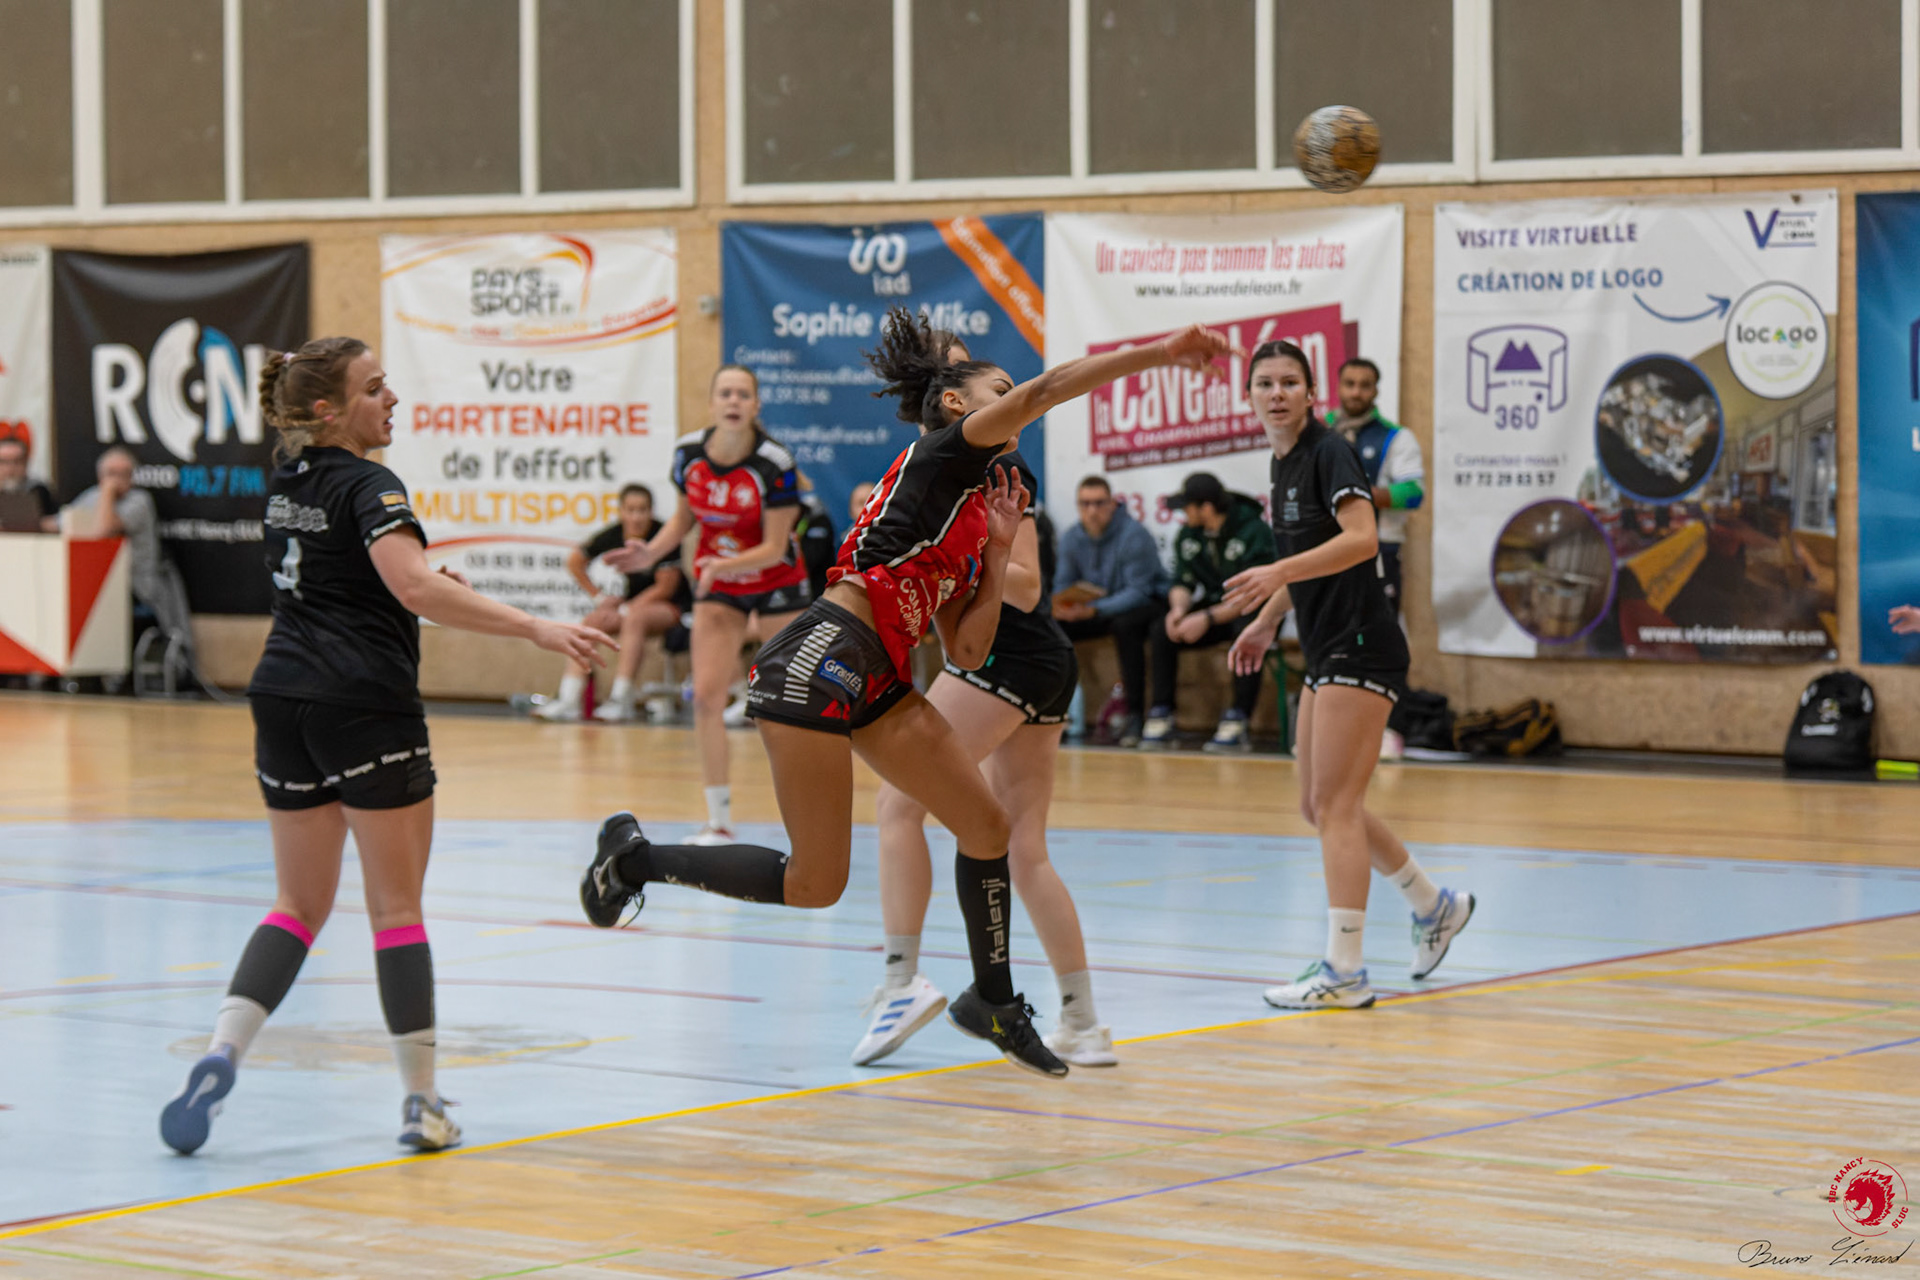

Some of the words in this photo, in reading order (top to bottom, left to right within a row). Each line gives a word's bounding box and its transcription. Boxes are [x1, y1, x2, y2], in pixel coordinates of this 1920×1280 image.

[1456, 228, 1519, 249] VISITE
[1526, 223, 1638, 246] VIRTUELLE
[1457, 267, 1564, 293] CRÉATION
[1572, 269, 1595, 289] DE
[1602, 267, 1663, 289] LOGO
[772, 302, 873, 344] Sophie
[482, 360, 574, 393] Votre
[412, 404, 650, 436] PARTENAIRE
[443, 450, 480, 479] de
[496, 449, 613, 480] l'effort
[981, 878, 1007, 965] kalenji
